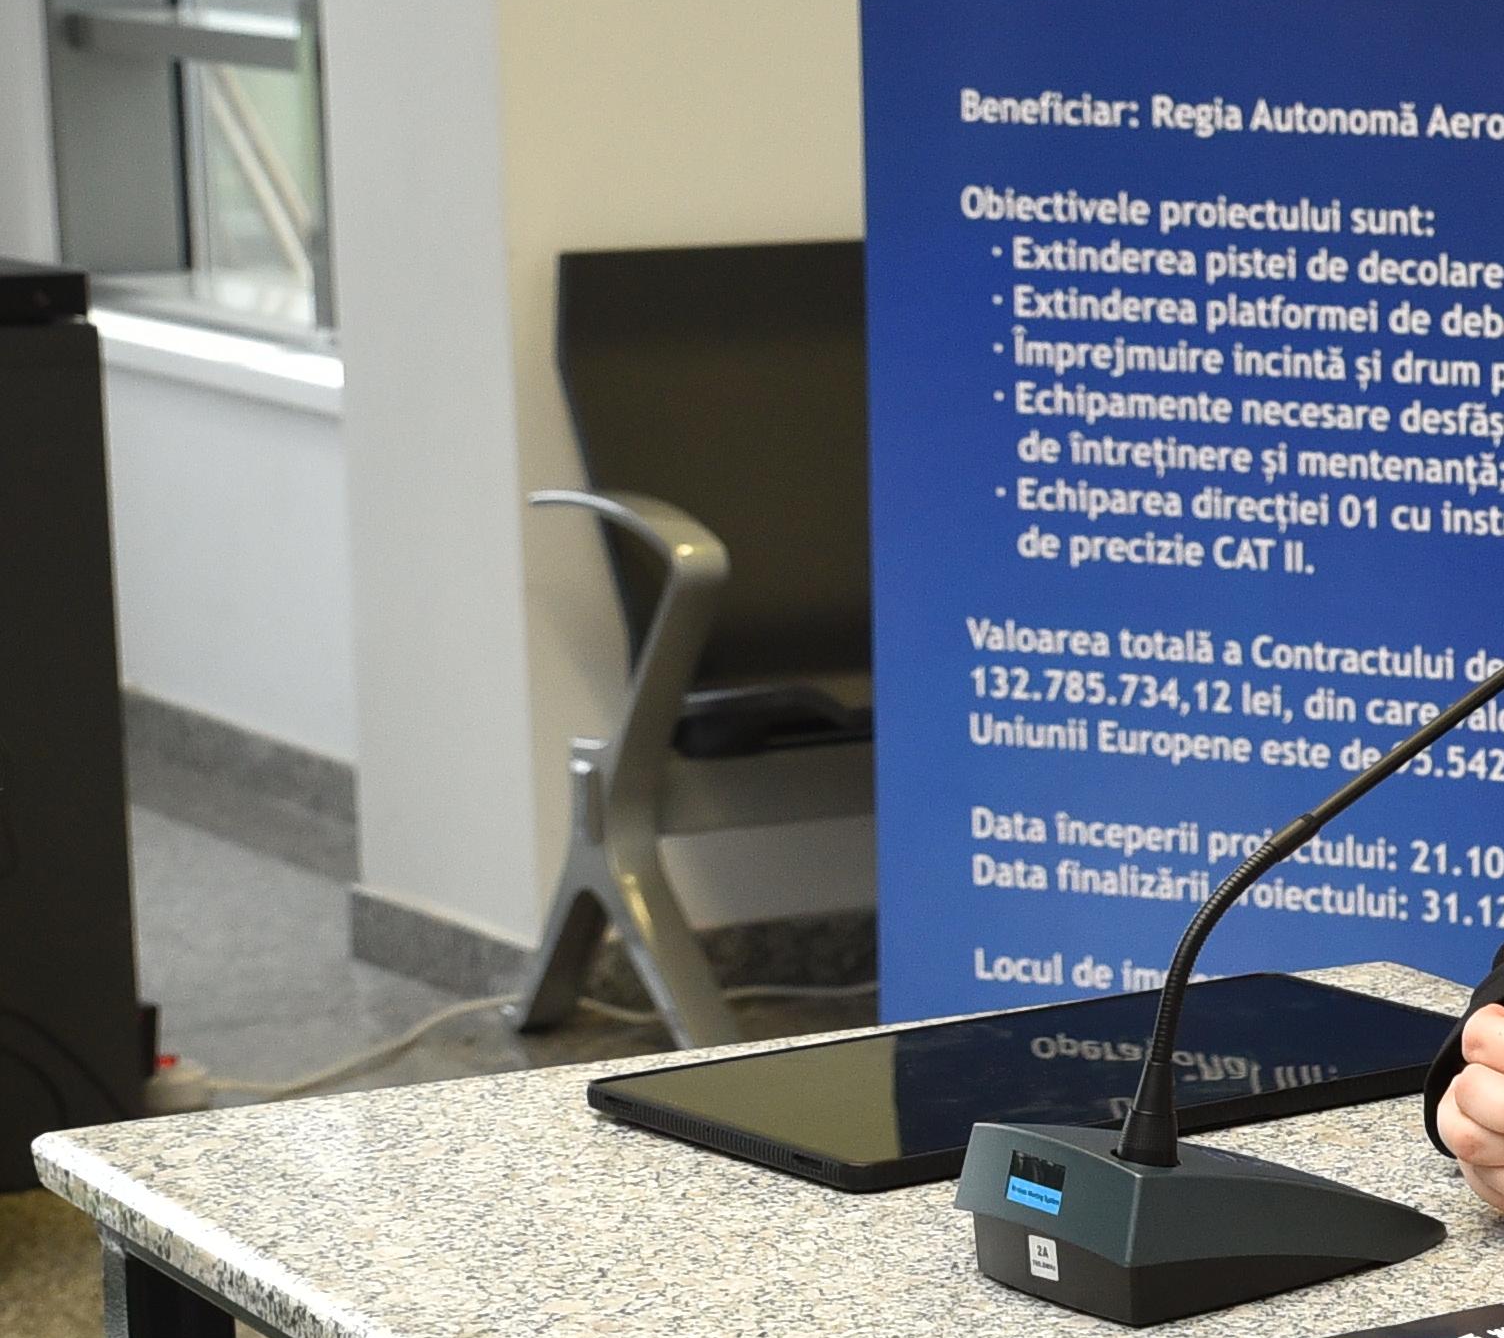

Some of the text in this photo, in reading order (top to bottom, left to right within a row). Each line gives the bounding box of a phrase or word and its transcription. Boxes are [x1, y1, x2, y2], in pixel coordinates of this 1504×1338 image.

[960, 88, 1140, 128] Beneficiar:
[1151, 94, 1244, 139] Regia
[1249, 99, 1419, 137] Autonomă
[960, 185, 1435, 237] Obiectivele proiectului sunt:
[1012, 235, 1197, 276] Extinderea
[1205, 244, 1297, 285] pistei
[1305, 247, 1349, 283] de
[1357, 250, 1504, 289] decolare
[1013, 284, 1198, 325] Extinderea
[1206, 292, 1379, 334] platformei
[1388, 300, 1432, 336] de
[1012, 321, 1226, 378] Împrejmuire
[1232, 342, 1347, 381] incintă
[1355, 349, 1382, 391] și
[1391, 350, 1481, 387] drum
[1015, 380, 1233, 425] Echipamente
[1241, 399, 1391, 432] necesare
[1017, 429, 1061, 464] de
[1068, 431, 1253, 478] întreținere
[1260, 442, 1288, 484] și
[1017, 476, 1183, 521] Echiparea
[1191, 486, 1329, 533] direcției
[1338, 494, 1377, 529] 01
[1390, 505, 1431, 532] cu
[1016, 524, 1315, 575] de precizie CAT II.
[966, 616, 1111, 657] Valoarea
[1118, 628, 1215, 664] totală
[1222, 639, 1243, 666] a
[1251, 634, 1455, 680] Contractului
[970, 665, 1233, 716] 132.785.734,12
[1241, 681, 1294, 724] lei,
[1304, 687, 1357, 723] din
[1365, 698, 1442, 730] care
[969, 712, 1088, 751] Uniunii
[1097, 719, 1253, 766] Europene
[1260, 737, 1331, 769] este
[971, 806, 1047, 843] Data
[1055, 811, 1199, 858] începerii
[1208, 827, 1399, 874] proctului:
[972, 853, 1048, 891] Data
[1056, 859, 1210, 903] finalizării
[973, 947, 1064, 986] Locul
[1071, 954, 1114, 990] de
[1036, 1244, 1049, 1259] 2A
